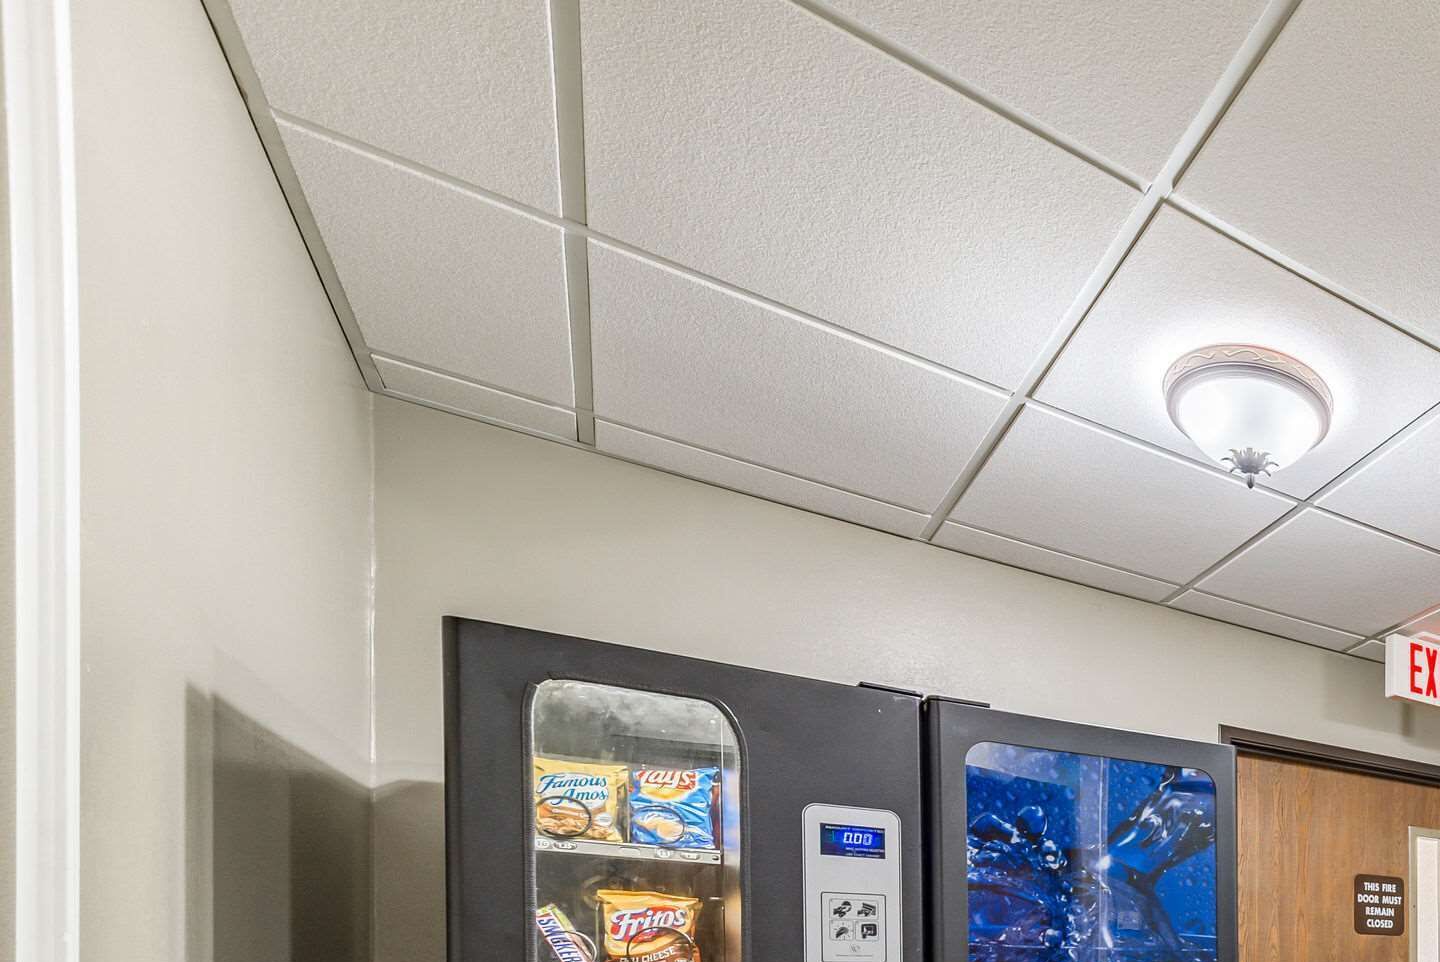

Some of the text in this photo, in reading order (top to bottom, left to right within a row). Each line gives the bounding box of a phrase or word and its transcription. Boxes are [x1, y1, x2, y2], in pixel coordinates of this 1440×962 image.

[536, 773, 608, 794] Famous
[550, 787, 609, 805] Amos
[1363, 882, 1397, 893] THIS FIRE
[1357, 893, 1402, 905] DOOR MUST
[1365, 907, 1395, 917] REMAIN
[611, 906, 688, 942] Fritos
[1366, 919, 1394, 929] CLOSED
